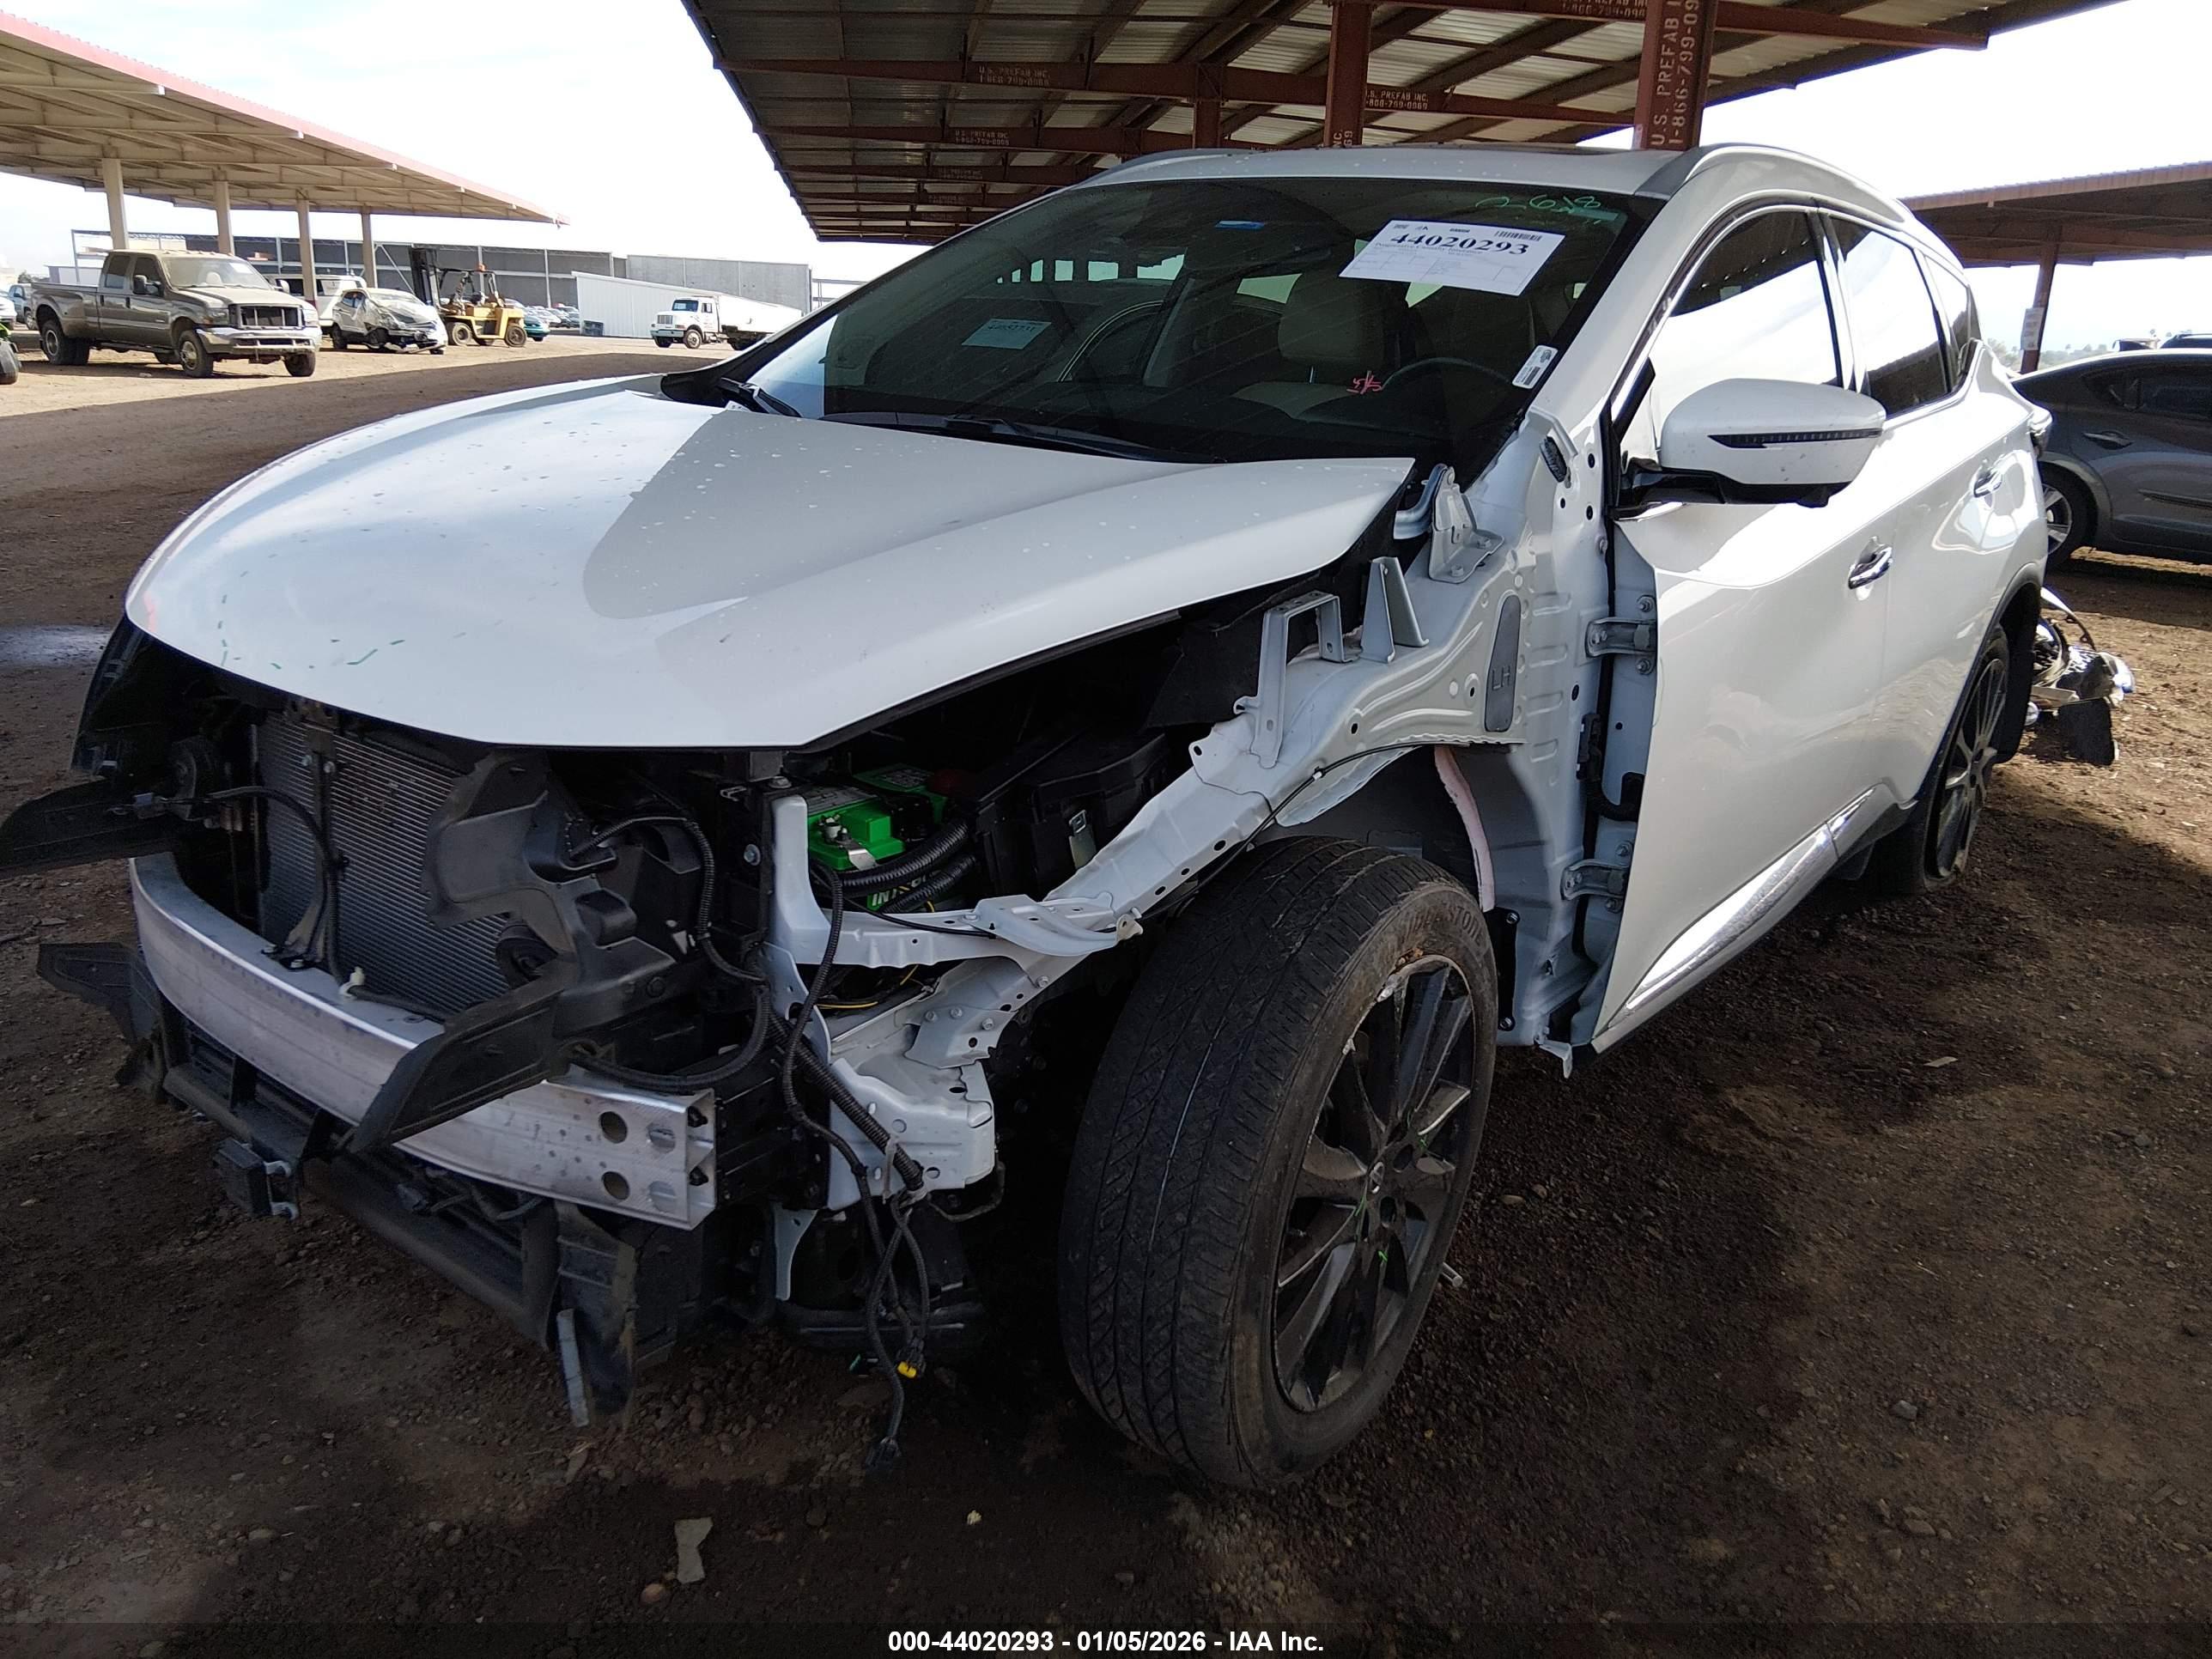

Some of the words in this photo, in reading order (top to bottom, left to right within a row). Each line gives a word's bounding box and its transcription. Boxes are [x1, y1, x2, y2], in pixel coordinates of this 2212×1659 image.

[1656, 17, 1680, 96] PREFAB
[1381, 90, 1411, 101] PREFAB
[1650, 107, 1668, 145] U.S.
[1390, 233, 1529, 255] 44020293
[1492, 665, 1511, 691] LH
